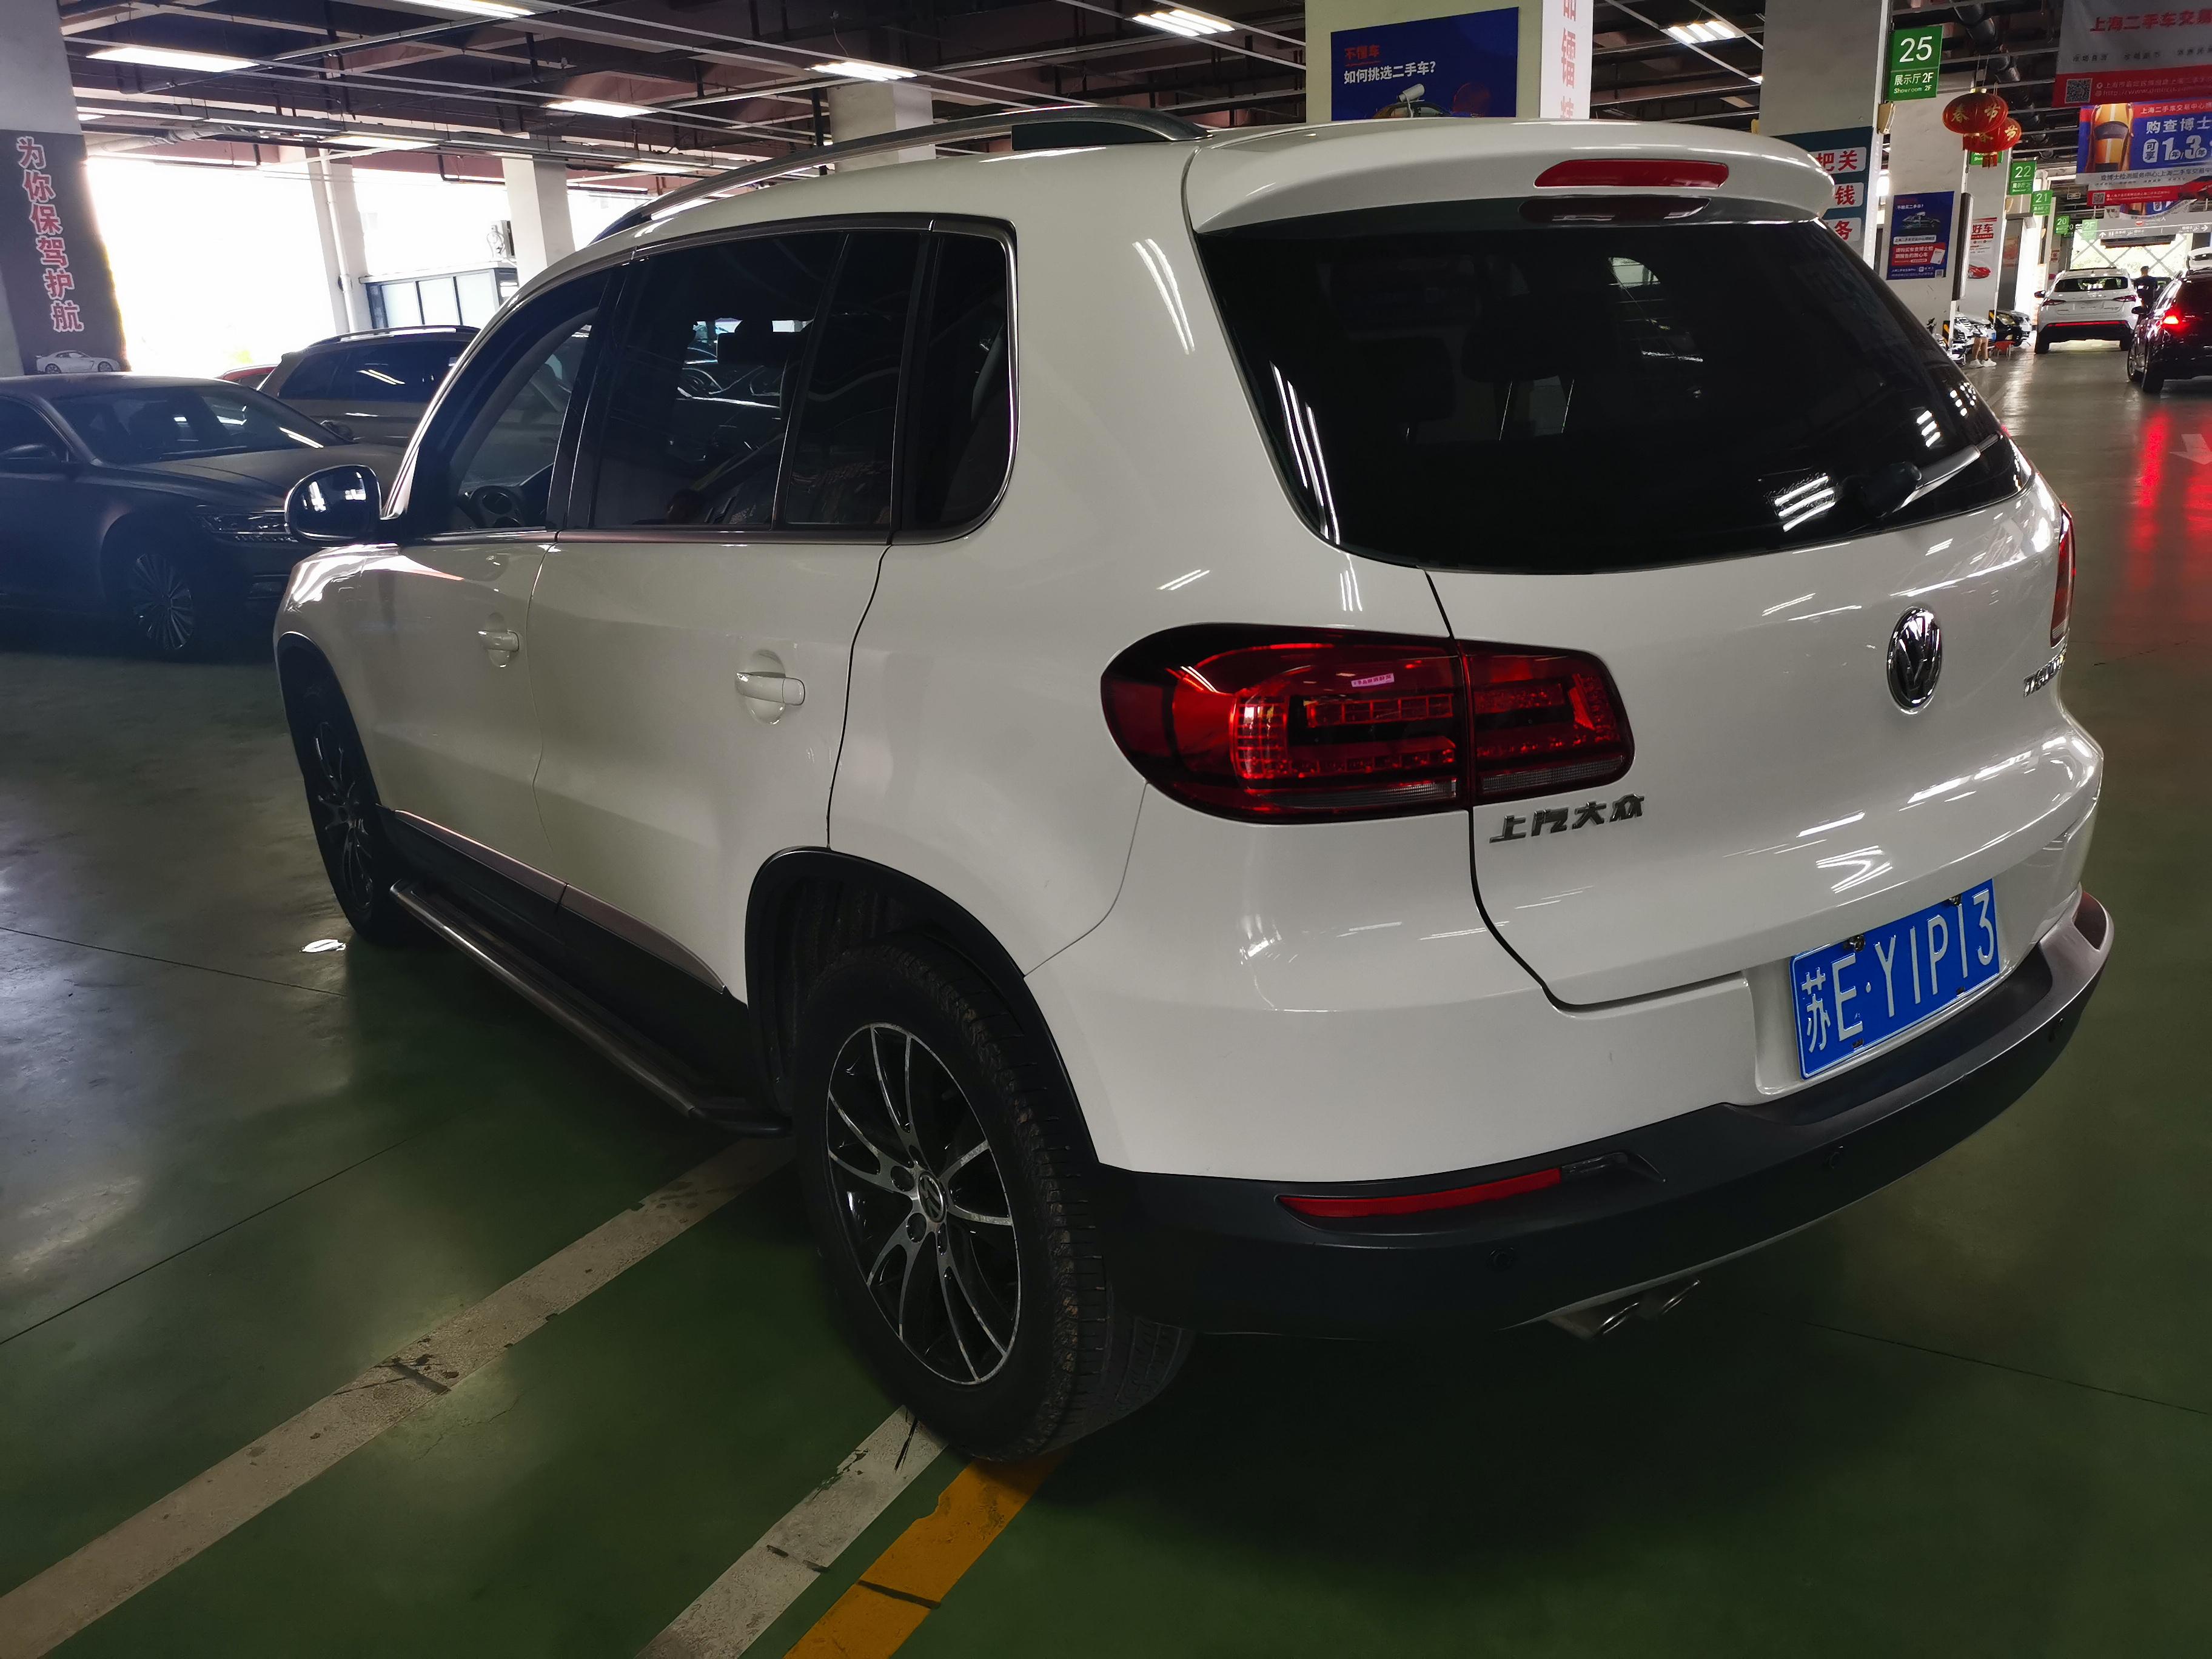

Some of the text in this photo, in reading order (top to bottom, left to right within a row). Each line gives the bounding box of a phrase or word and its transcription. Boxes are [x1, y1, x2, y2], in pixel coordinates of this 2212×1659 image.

[1344, 45, 1380, 60] 不懂车
[1899, 36, 1932, 62] 25
[1894, 72, 1934, 85] 展示厅 2F
[2146, 116, 2212, 134] 购查博士
[2145, 141, 2157, 161] 可享
[1815, 150, 1858, 172] 把关
[2014, 166, 2031, 178] 22
[1835, 185, 1855, 205] 钱
[2036, 193, 2047, 203] 21
[16, 136, 84, 332] 为你保驾护航
[1972, 224, 1993, 234] 好车
[1489, 793, 1644, 843] 上汽大众
